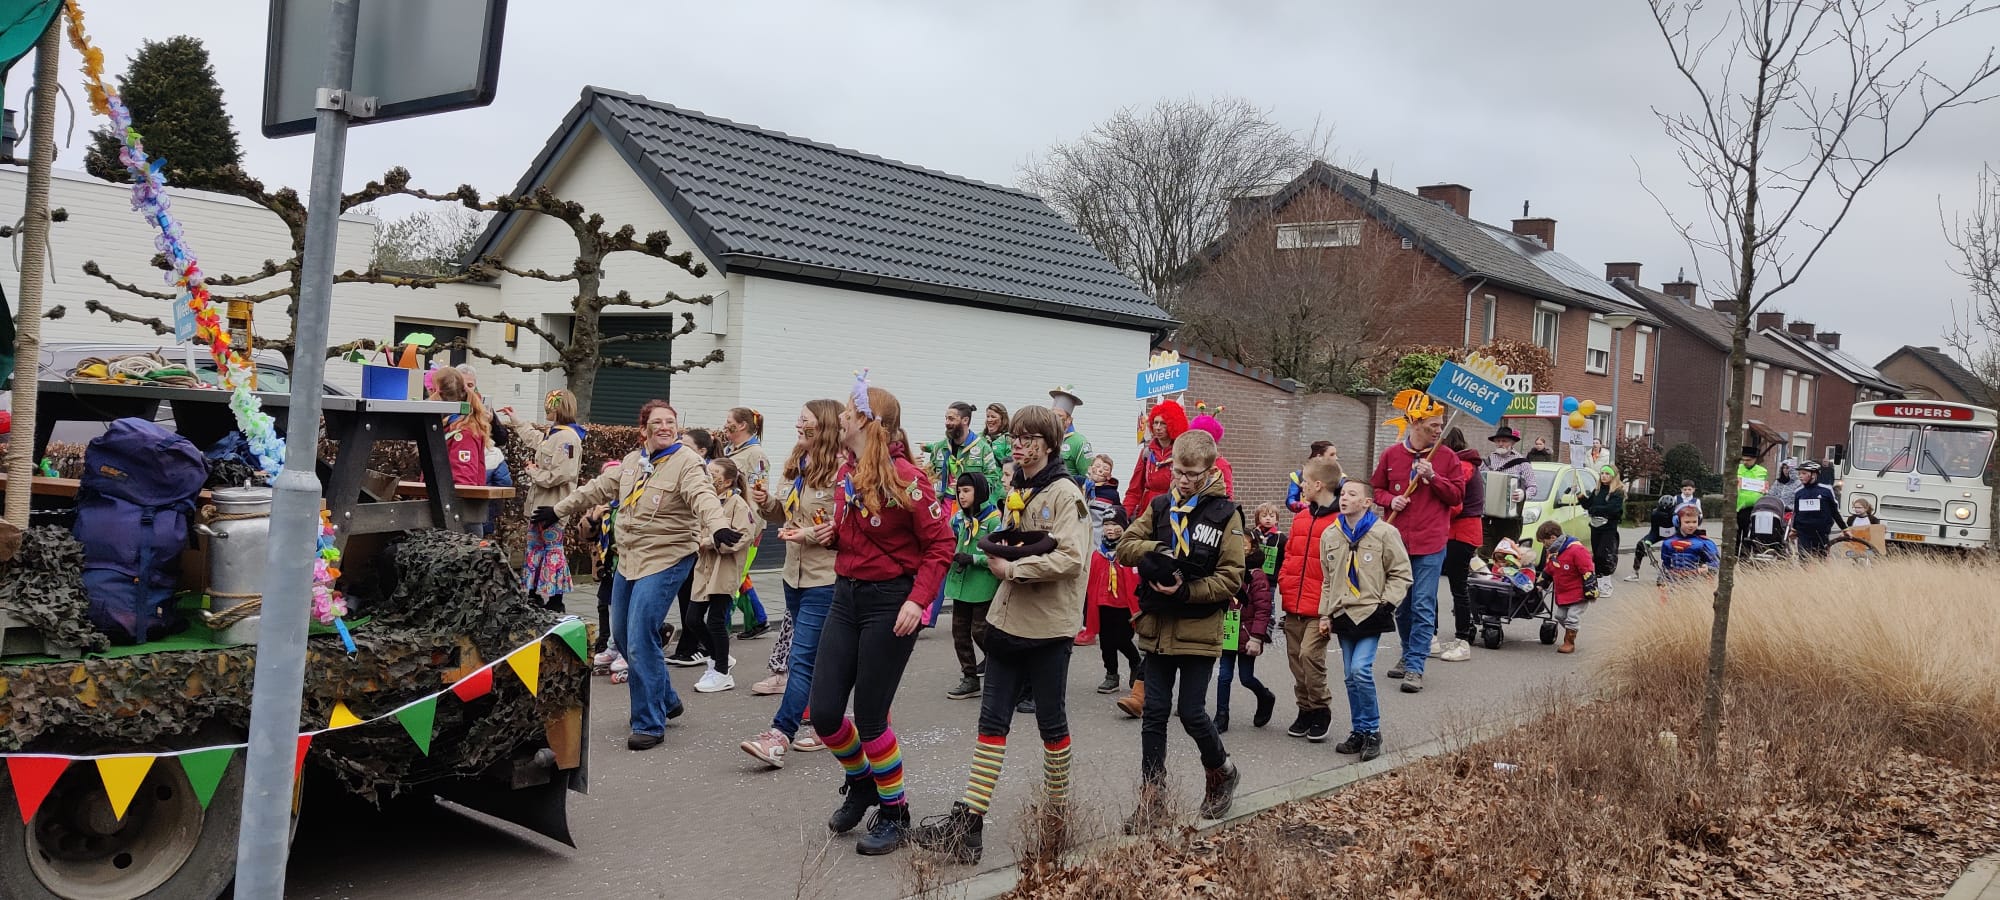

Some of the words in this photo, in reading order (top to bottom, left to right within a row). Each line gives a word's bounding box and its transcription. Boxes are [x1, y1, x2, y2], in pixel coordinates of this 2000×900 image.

[1145, 367, 1180, 384] Wieërt
[1451, 369, 1500, 405] Wieërt
[1446, 389, 1483, 413] Luueke
[1894, 406, 1952, 418] KUPERS
[1908, 477, 1920, 486] 12
[1192, 523, 1222, 548] SWAT
